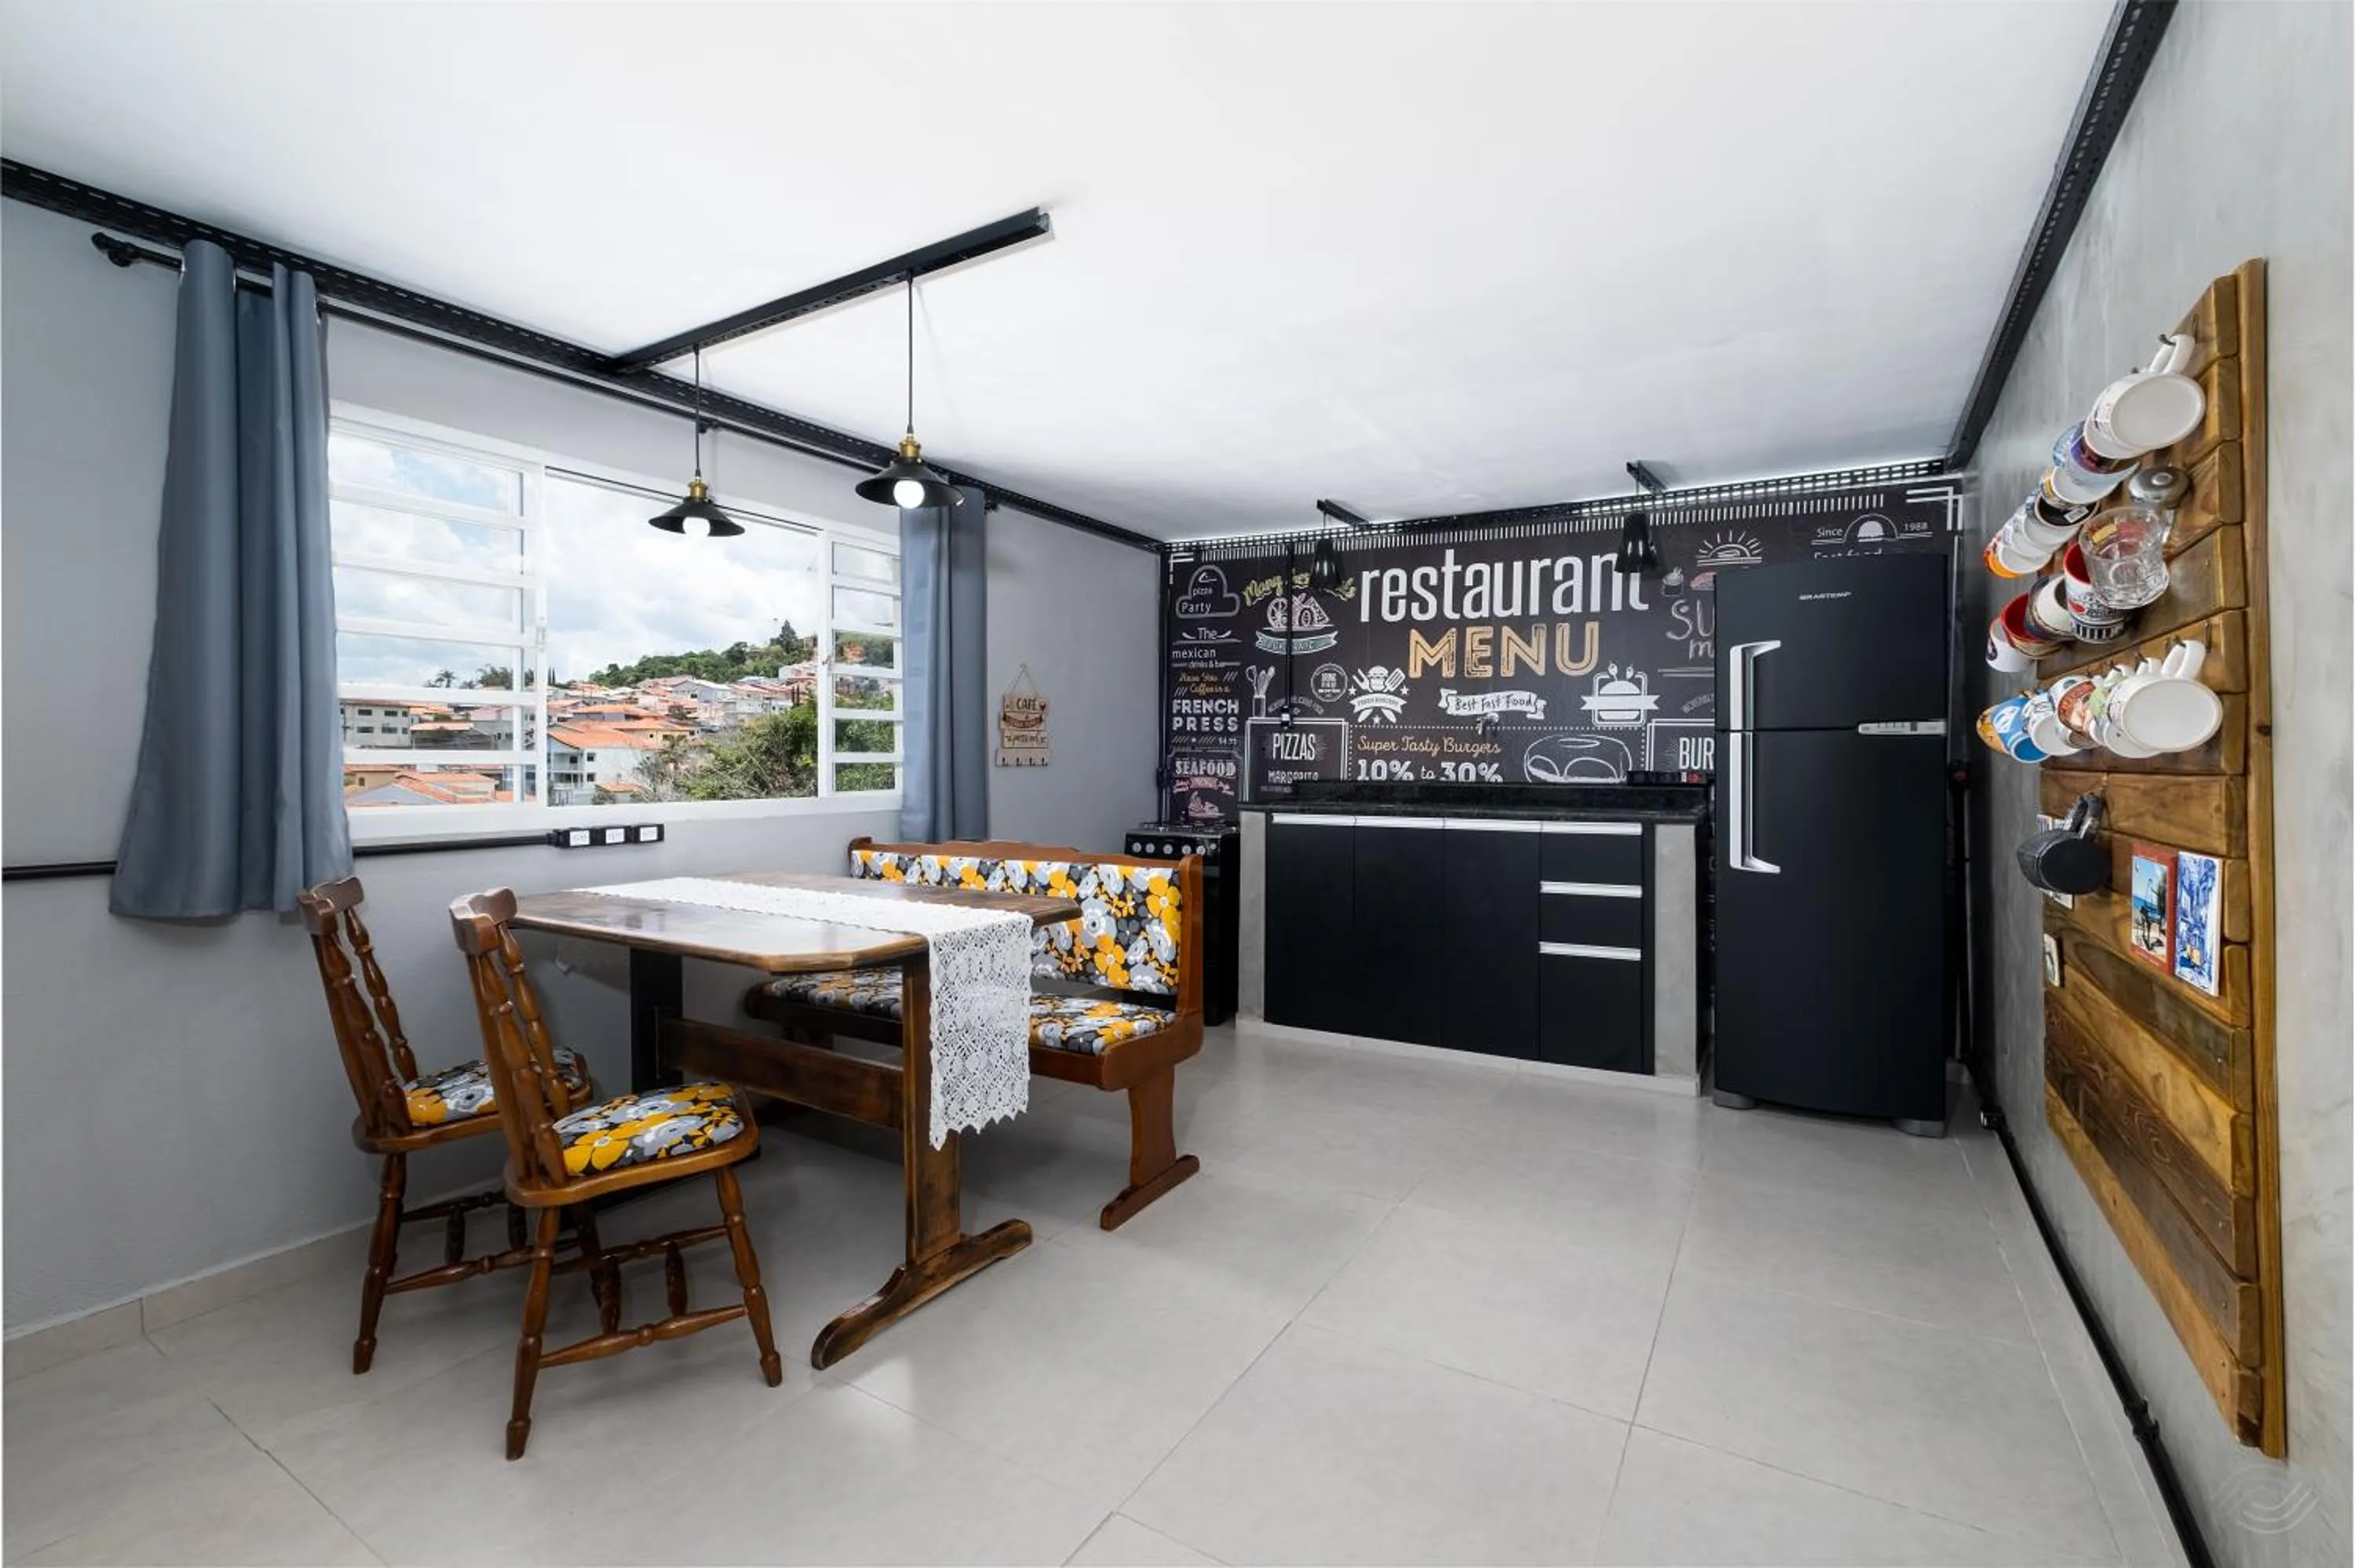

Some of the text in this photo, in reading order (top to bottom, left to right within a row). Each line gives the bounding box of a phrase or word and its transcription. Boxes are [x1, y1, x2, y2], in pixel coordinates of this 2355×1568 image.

[1816, 522, 1929, 538] Since 1988
[1181, 602, 1211, 614] Party
[1197, 627, 1218, 640] The
[1172, 648, 1216, 658] mexican
[1408, 621, 1600, 679] MENU
[1173, 699, 1240, 714] FRENCH
[1455, 694, 1532, 712] Best Fast Food
[1173, 717, 1238, 732] PRESS
[1272, 733, 1316, 760] PIZZAS
[1357, 735, 1502, 758] Super Tasty Burgers
[1679, 736, 1714, 770] BUR
[1175, 760, 1236, 777] SEAFOOD
[1356, 759, 1504, 783] 10% to 30%
